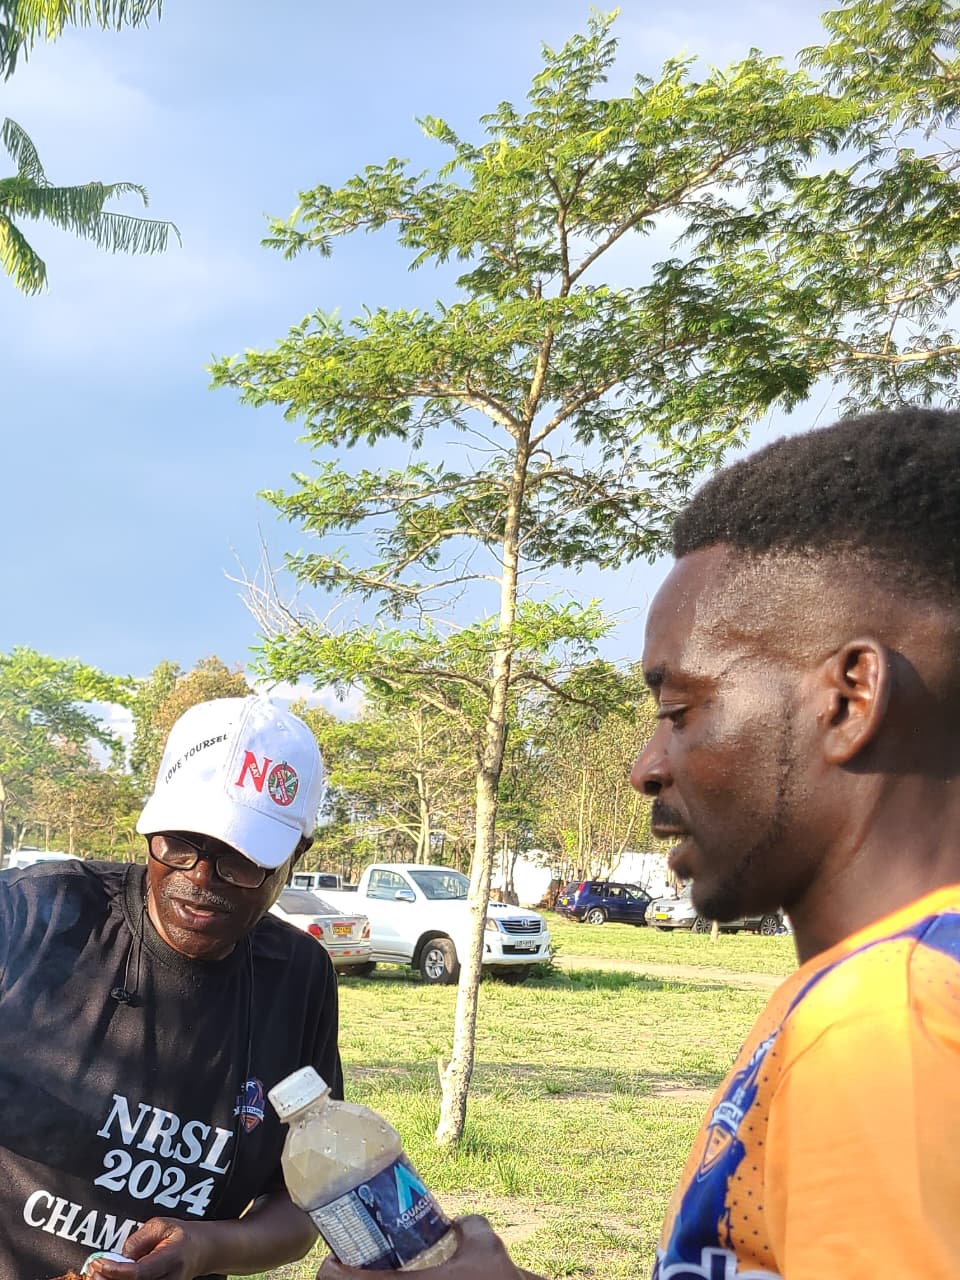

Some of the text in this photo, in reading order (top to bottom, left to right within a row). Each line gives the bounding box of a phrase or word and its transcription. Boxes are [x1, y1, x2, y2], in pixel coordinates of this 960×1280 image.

[165, 758, 183, 785] LOVE
[96, 1093, 234, 1175] NRSL
[94, 1148, 216, 1217] 2024
[23, 1189, 144, 1254] CHAM
